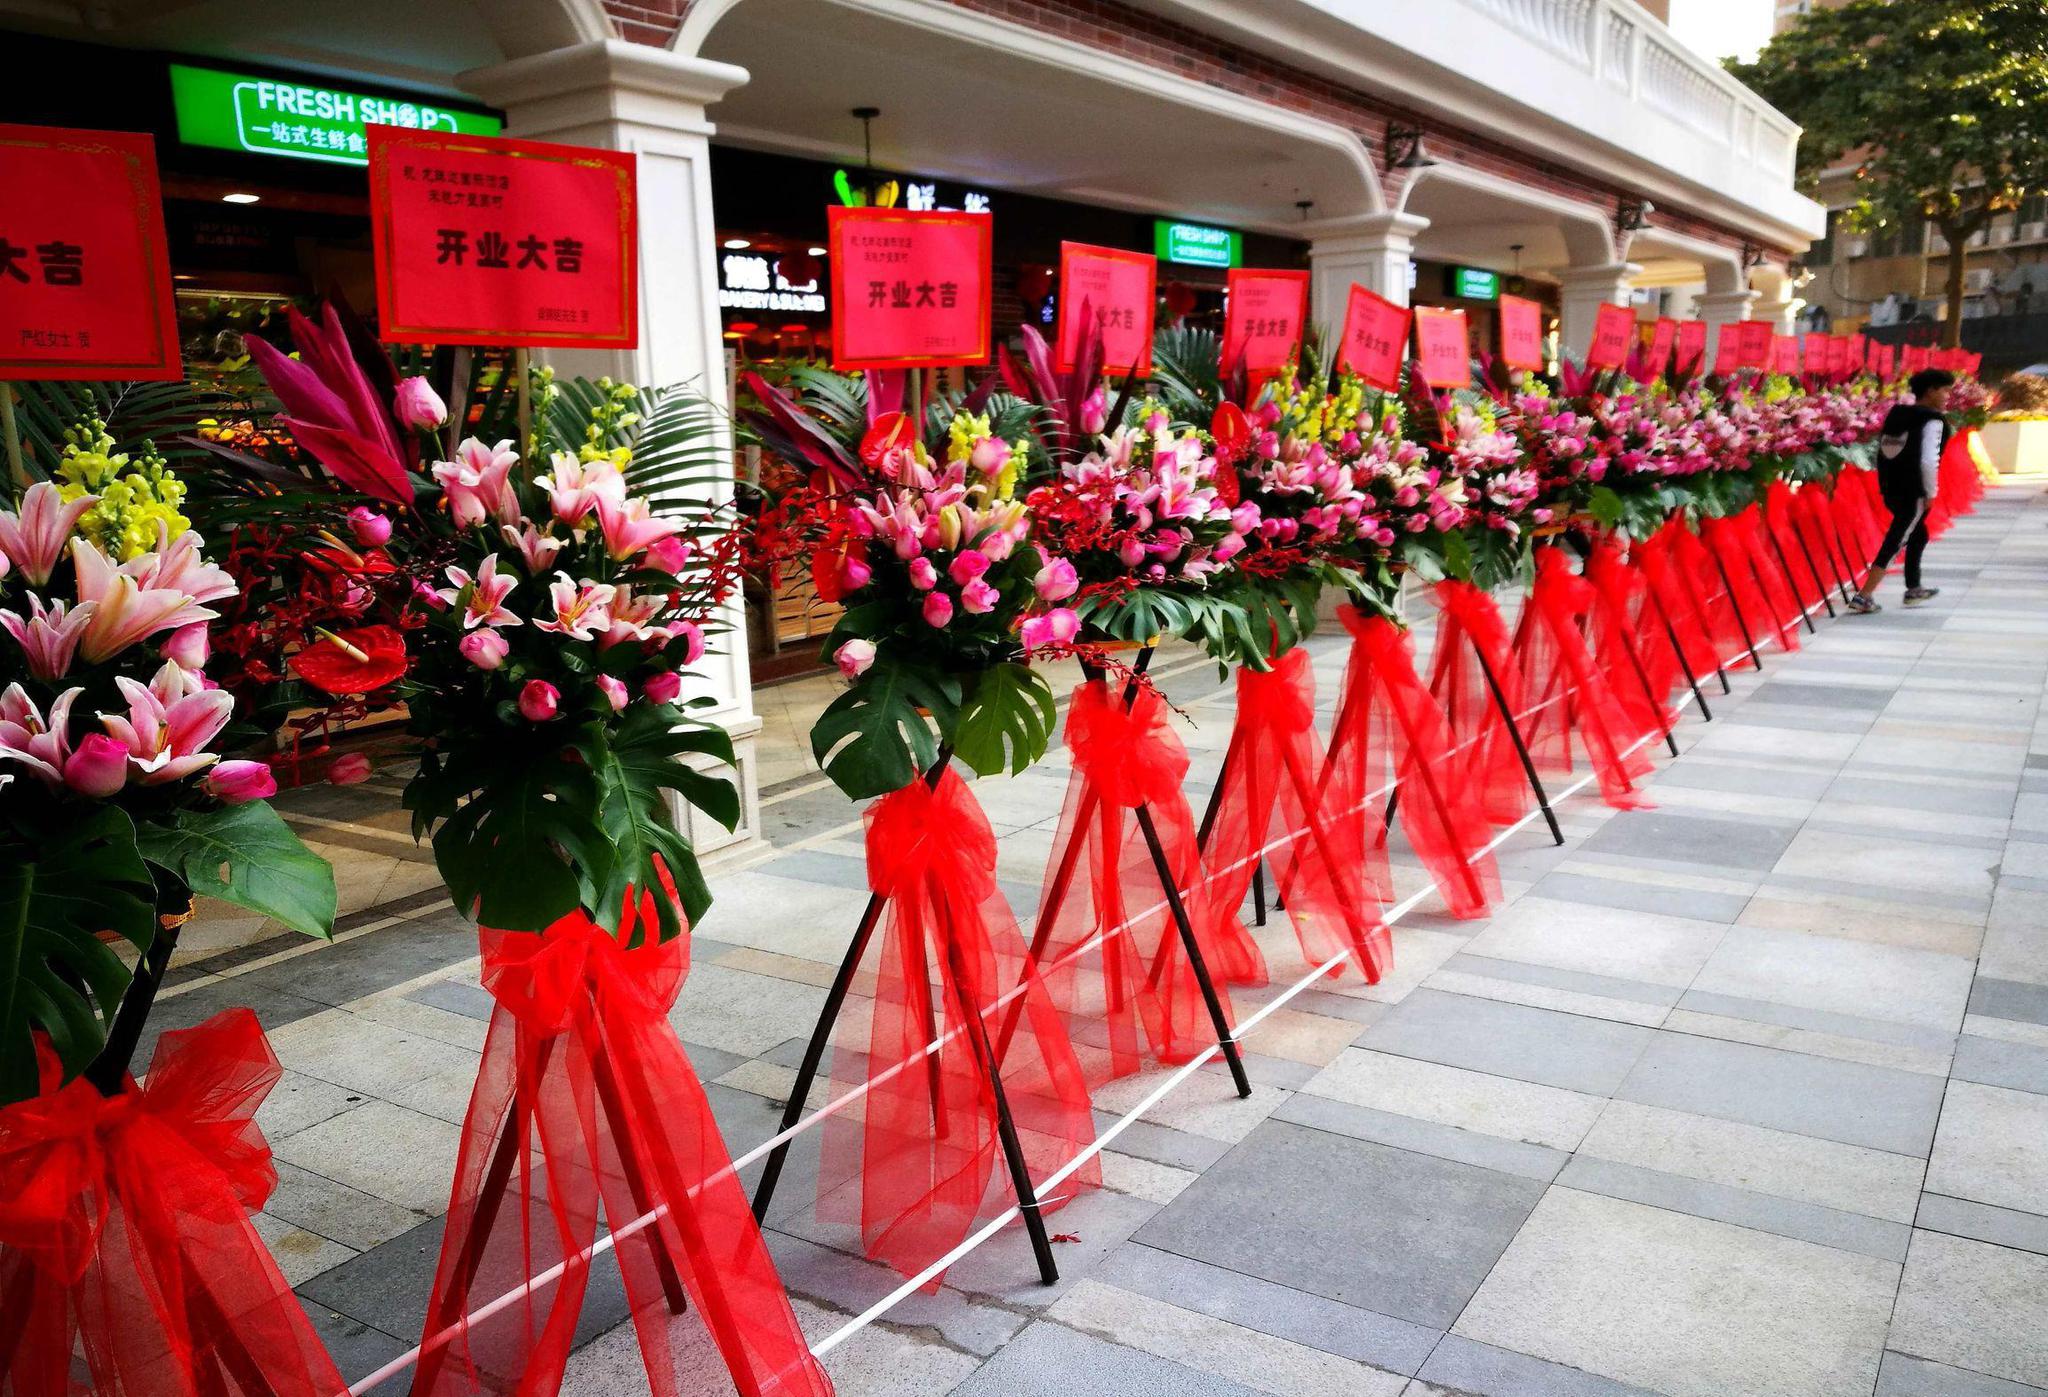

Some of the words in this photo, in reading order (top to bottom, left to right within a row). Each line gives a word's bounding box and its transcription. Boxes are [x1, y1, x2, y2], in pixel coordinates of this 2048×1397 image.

[257, 81, 355, 122] FRESH
[252, 121, 367, 153] 一站式生鲜食
[436, 229, 584, 274] 开业大吉
[868, 280, 958, 309] 开业大吉
[1244, 318, 1288, 337] 开业大吉
